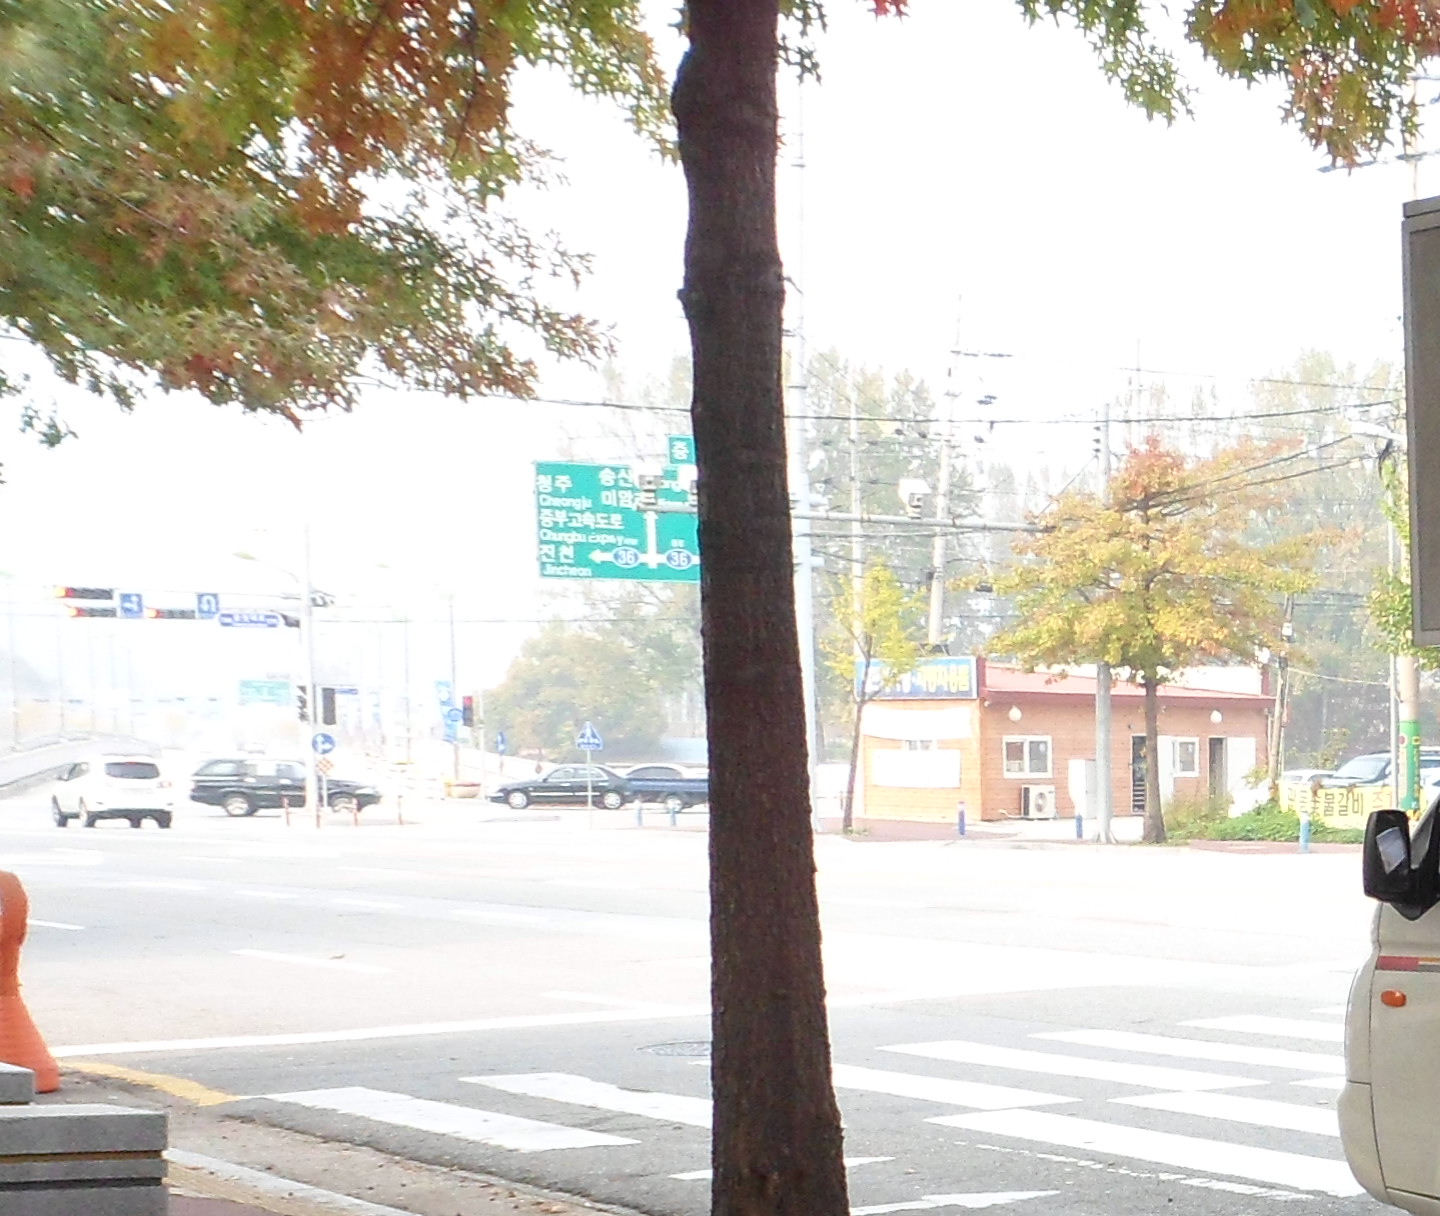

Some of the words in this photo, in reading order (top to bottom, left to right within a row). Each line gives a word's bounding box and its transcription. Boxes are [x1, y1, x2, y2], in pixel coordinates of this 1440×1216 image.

[538, 475, 573, 493] 청주
[601, 490, 638, 510] 미암
[539, 508, 624, 529] 중부고속도로
[540, 544, 574, 563] 진천
[618, 551, 635, 564] 36
[670, 552, 688, 566] 36
